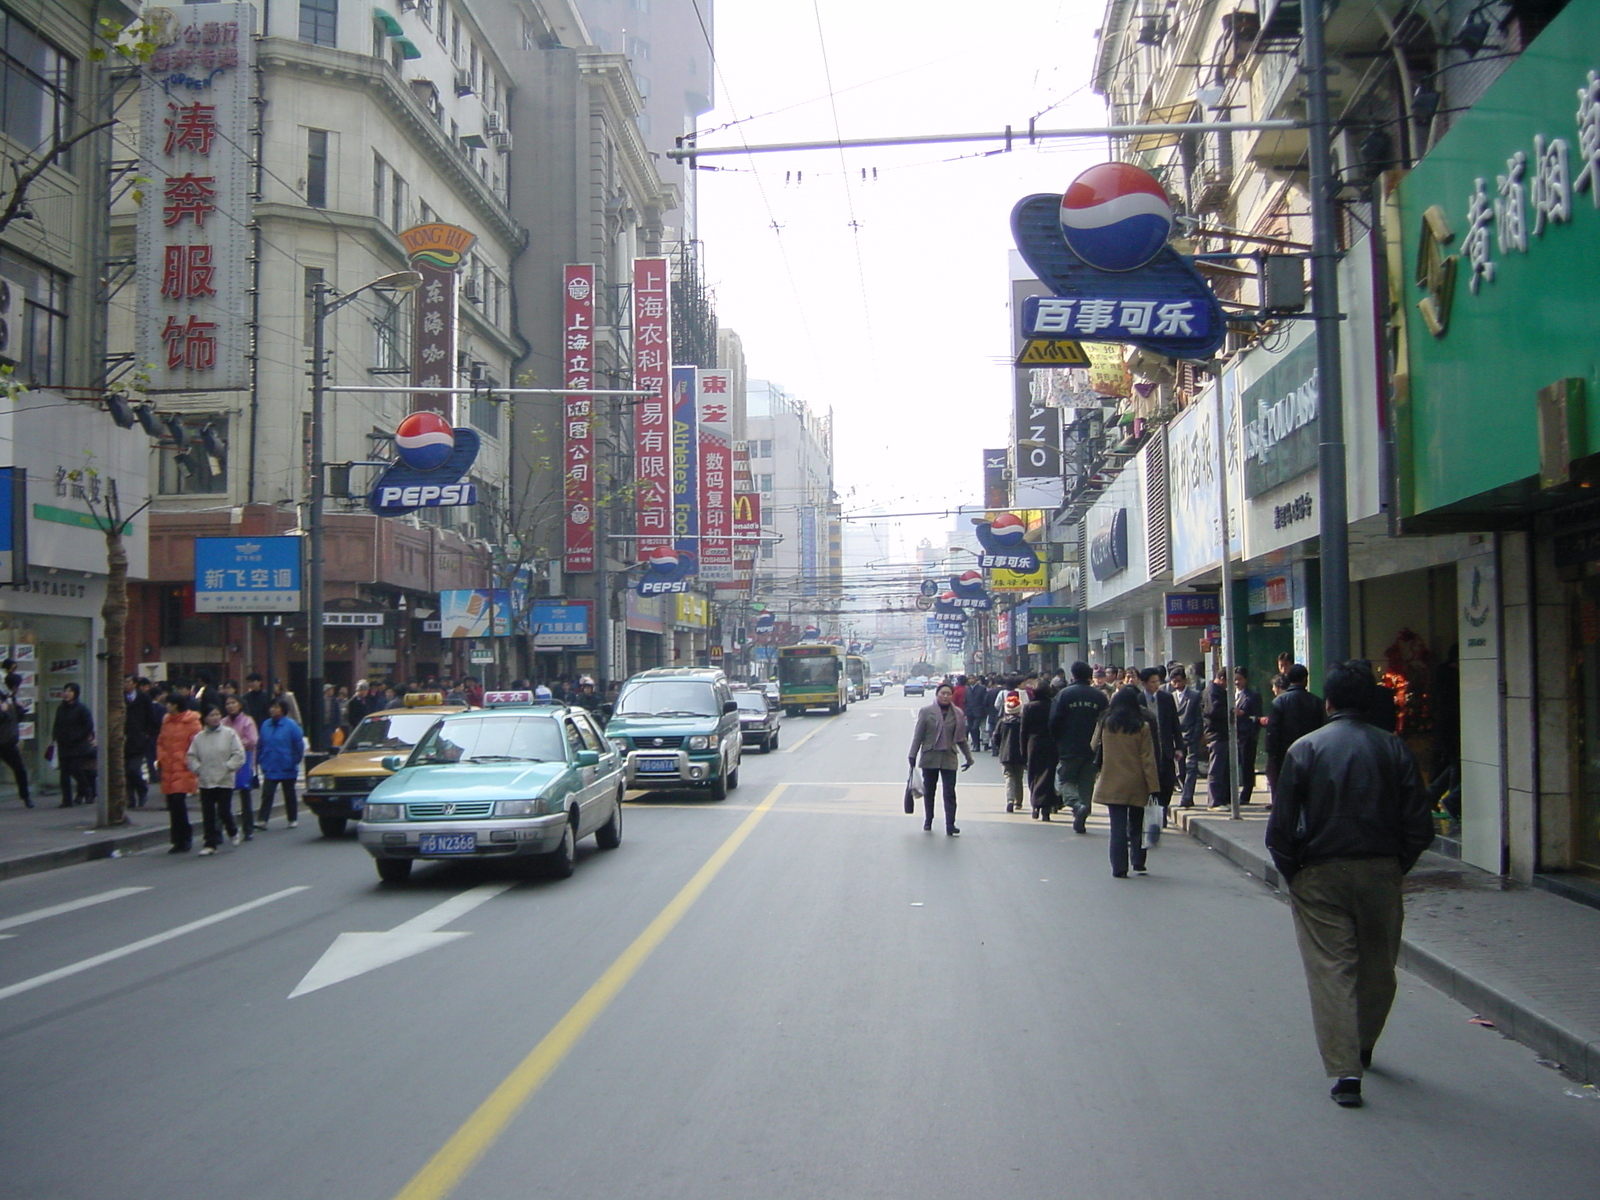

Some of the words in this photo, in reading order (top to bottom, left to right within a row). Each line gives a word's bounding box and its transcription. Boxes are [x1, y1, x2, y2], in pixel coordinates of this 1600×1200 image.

[160, 101, 218, 371] 涛奔服饰
[405, 226, 443, 250] DONG
[446, 227, 469, 251] HAI
[1033, 299, 1196, 336] 百事可乐
[637, 271, 667, 529] 上海农科贸易有限公司
[1267, 392, 1297, 447] POLO
[674, 420, 690, 494] Athlete's
[380, 485, 470, 507] PEPSI
[706, 452, 725, 545] 数码复印机
[675, 503, 691, 541] Foo
[981, 554, 1031, 569] 百事可乐
[205, 569, 292, 588] 新飞空调
[642, 582, 687, 593] PEPSI
[1171, 598, 1215, 611] 照相机
[493, 693, 523, 702] 大众
